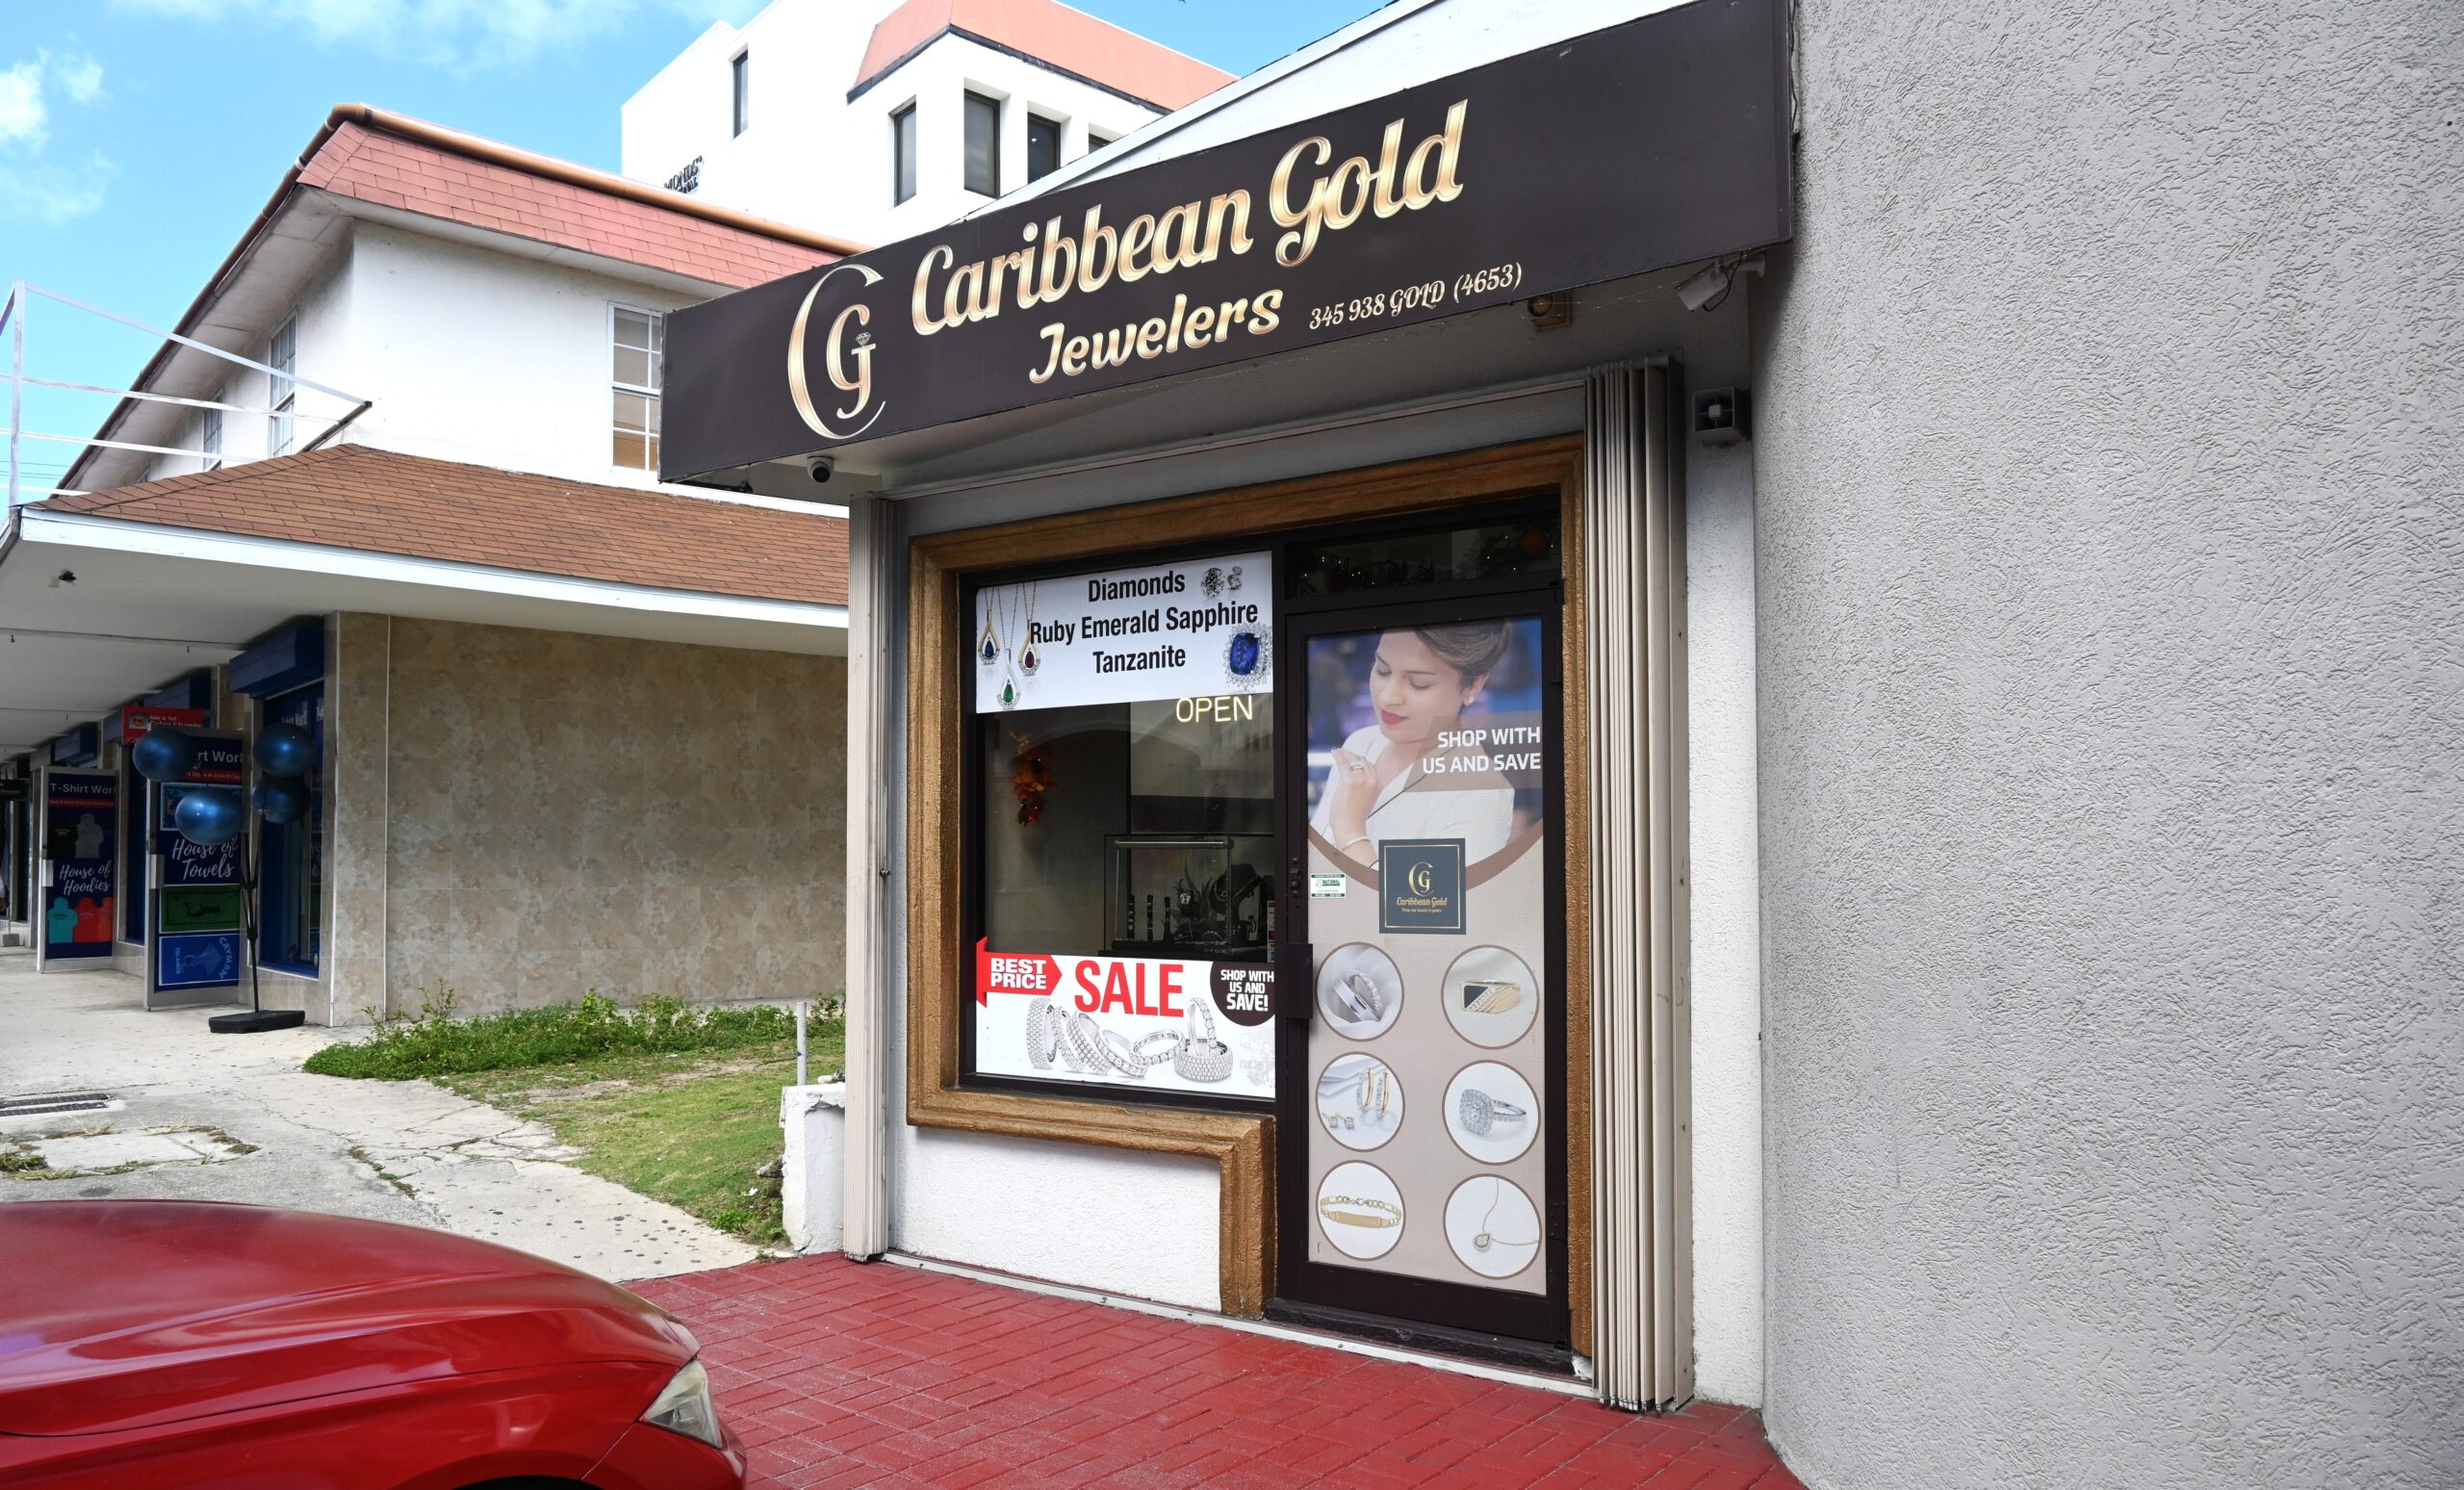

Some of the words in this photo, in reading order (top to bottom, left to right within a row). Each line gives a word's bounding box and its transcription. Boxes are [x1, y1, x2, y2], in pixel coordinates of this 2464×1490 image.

[911, 187, 1254, 335] Caribbean
[1269, 98, 1469, 268] Gold
[1309, 302, 1345, 330] 345
[1348, 294, 1386, 321] 938
[1389, 280, 1446, 317] GOLD
[1453, 262, 1523, 304] (4653)
[1029, 289, 1284, 384] Jewelers
[1089, 570, 1186, 603] Diamonds
[1030, 621, 1075, 646] Ruby
[1082, 609, 1160, 639] Emerald
[1167, 600, 1258, 633] Sapphire
[1093, 645, 1186, 674] Tanzanite
[1176, 695, 1253, 723] OPEN
[1438, 730, 1487, 749] SHOP
[1492, 727, 1540, 745] WITH
[1423, 758, 1446, 774] US
[1450, 756, 1489, 773] AND
[1494, 753, 1541, 771] SAVE
[50, 783, 89, 794] T-Shirt
[171, 838, 218, 861] House
[59, 864, 94, 880] House
[98, 860, 112, 878] of
[182, 853, 235, 881] Towels
[63, 877, 110, 895] Hoodies
[990, 957, 1046, 974] BEST
[1220, 969, 1246, 981] SHOP
[1248, 970, 1274, 983] WITH
[990, 972, 1046, 989] PRICE
[1074, 960, 1184, 1017] SALE
[1229, 982, 1243, 992] US
[1245, 982, 1266, 993] AND
[1226, 992, 1269, 1012] SAVE!
